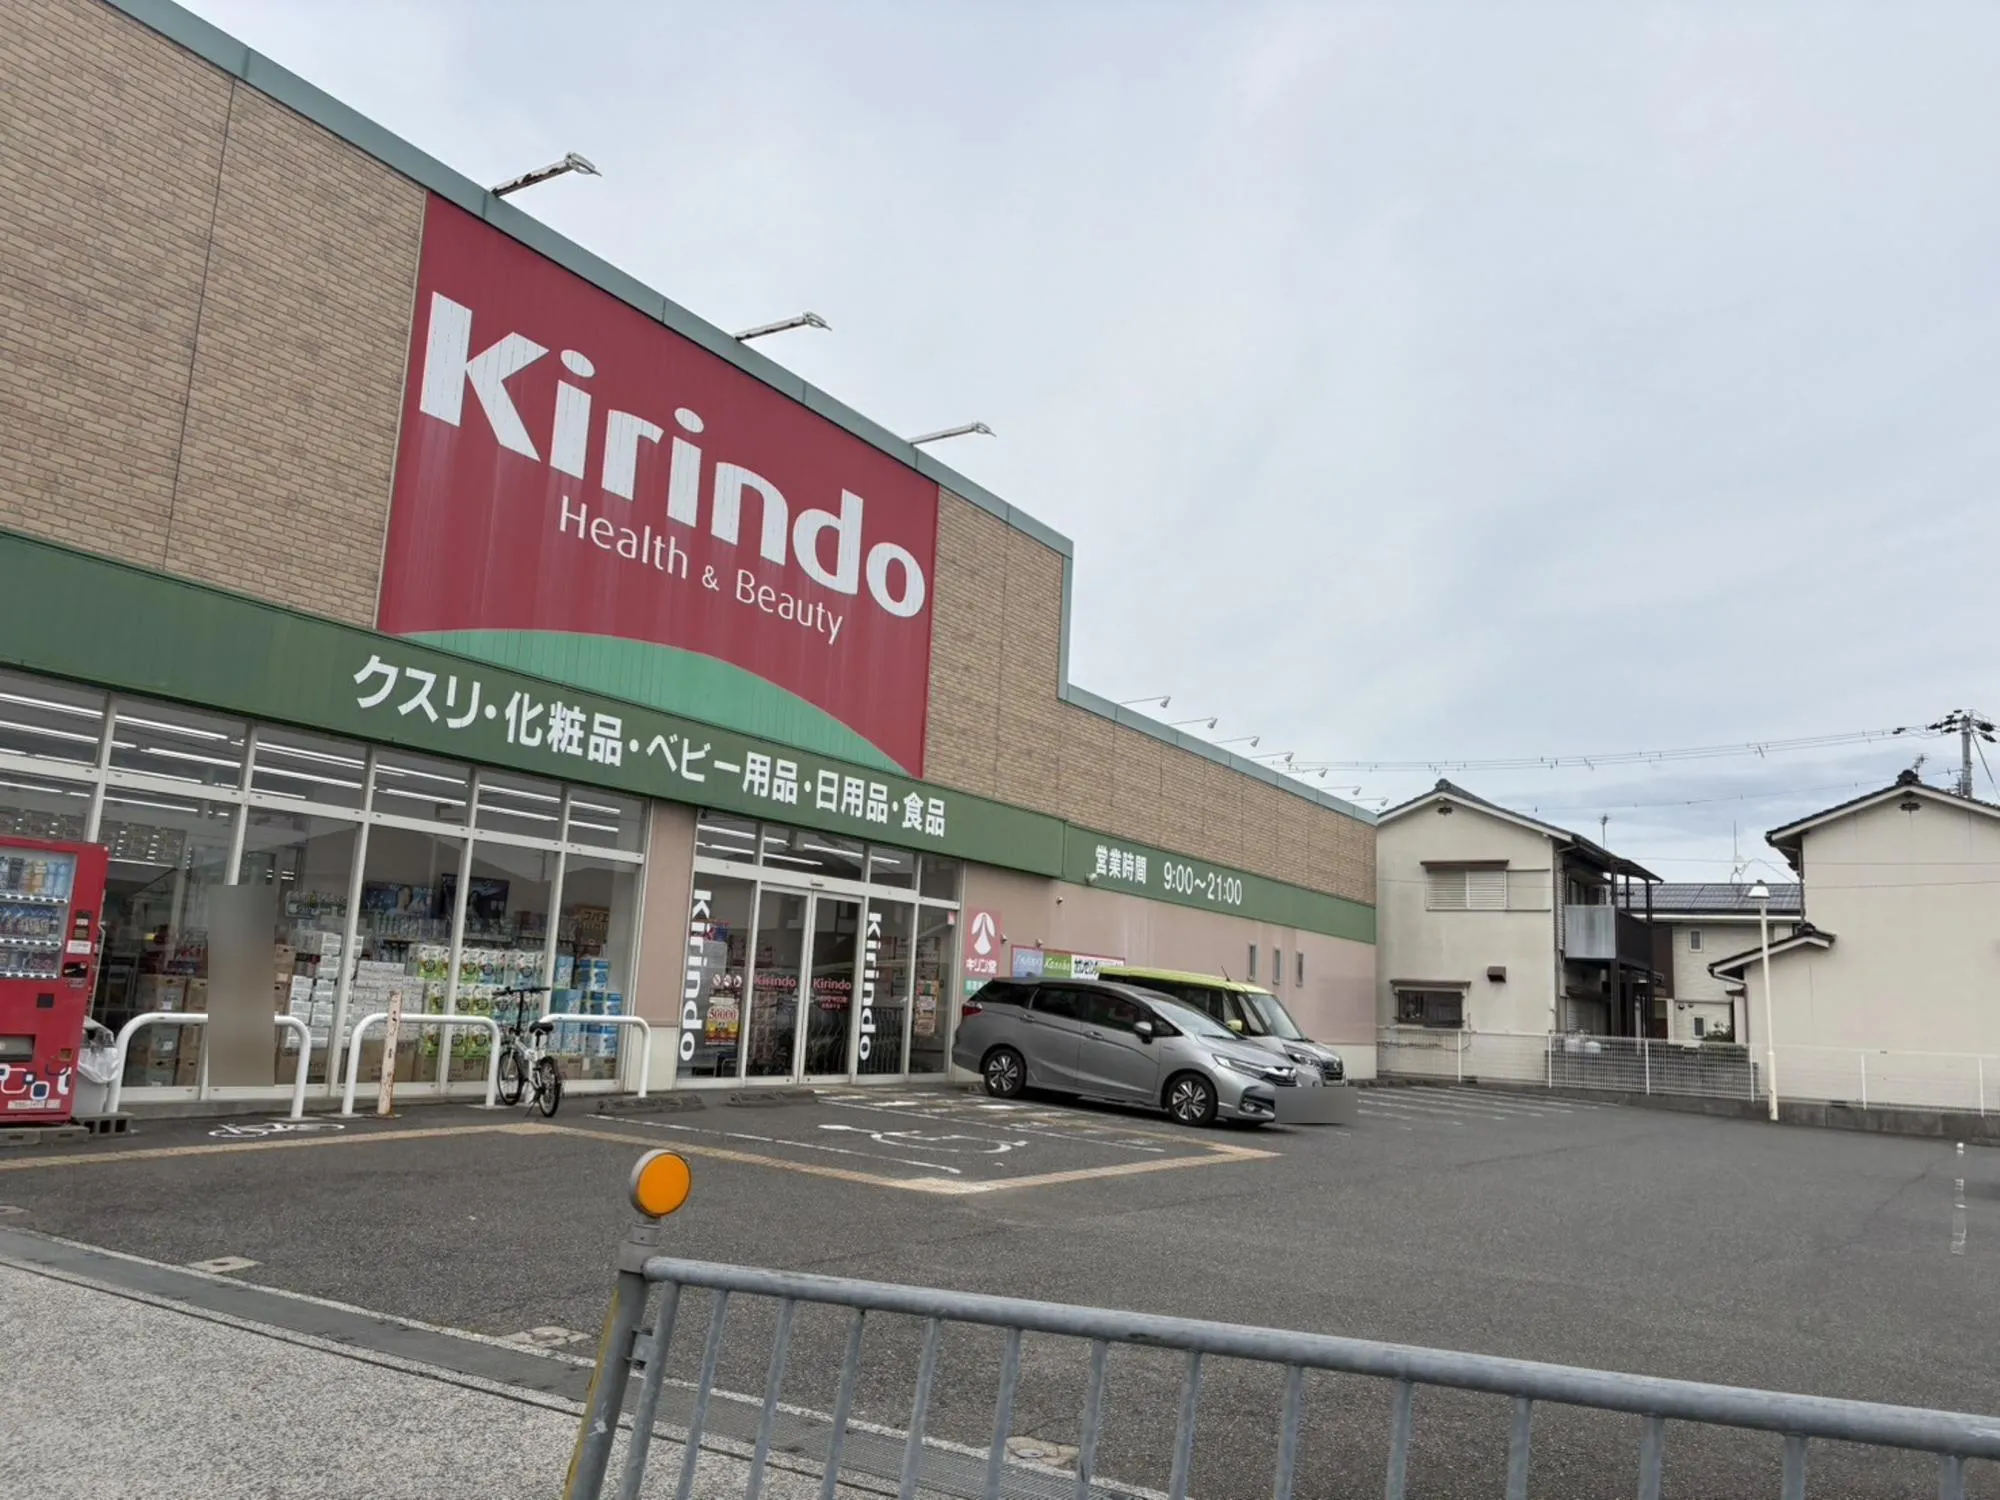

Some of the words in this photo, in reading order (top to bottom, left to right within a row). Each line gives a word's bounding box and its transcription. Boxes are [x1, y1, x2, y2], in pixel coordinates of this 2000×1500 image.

[419, 290, 926, 618] Kirindo
[559, 494, 689, 580] Health
[701, 564, 720, 592] &
[735, 569, 843, 645] Beauty
[1095, 844, 1148, 884] 営業時間
[679, 889, 712, 1062] Kirindo
[755, 974, 797, 988] Kirindo
[813, 978, 852, 990] Kirindo
[859, 911, 882, 1061] Kirindo
